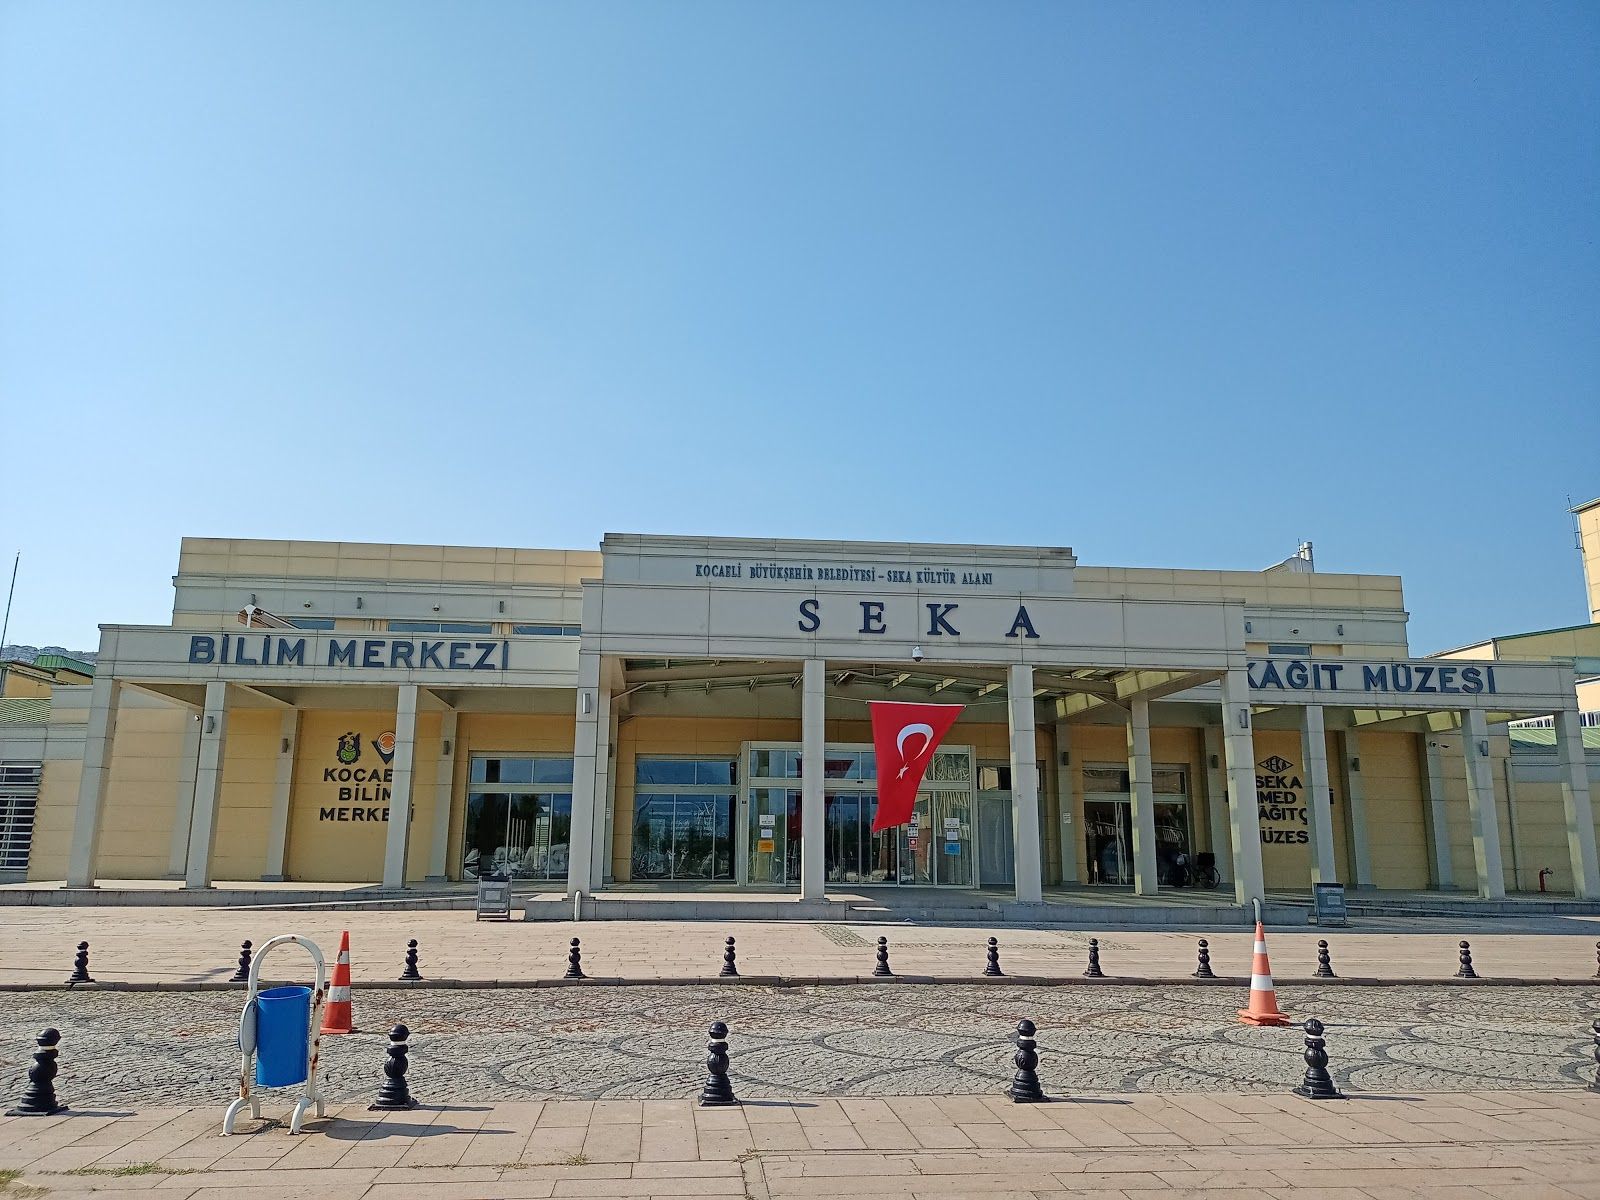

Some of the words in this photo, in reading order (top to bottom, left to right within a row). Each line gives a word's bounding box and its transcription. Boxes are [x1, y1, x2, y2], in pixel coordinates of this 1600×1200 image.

[695, 563, 741, 577] KOCAELİ
[749, 563, 813, 581] BÜYÜKŞEHİR
[817, 565, 876, 582] BELEDİYESİ
[887, 570, 912, 583] SEKA
[916, 568, 956, 584] KÜLTÜR
[961, 572, 993, 585] ALANI
[189, 634, 305, 666] BİLİM
[328, 639, 509, 670] MERKEZİ
[1362, 663, 1496, 694] MÜZESİ
[1265, 760, 1287, 771] SEKA
[323, 768, 393, 782] KOCAE
[1256, 775, 1303, 789] SEKA
[319, 803, 414, 822] MERKEİ
[1260, 826, 1309, 844] ÜZES
